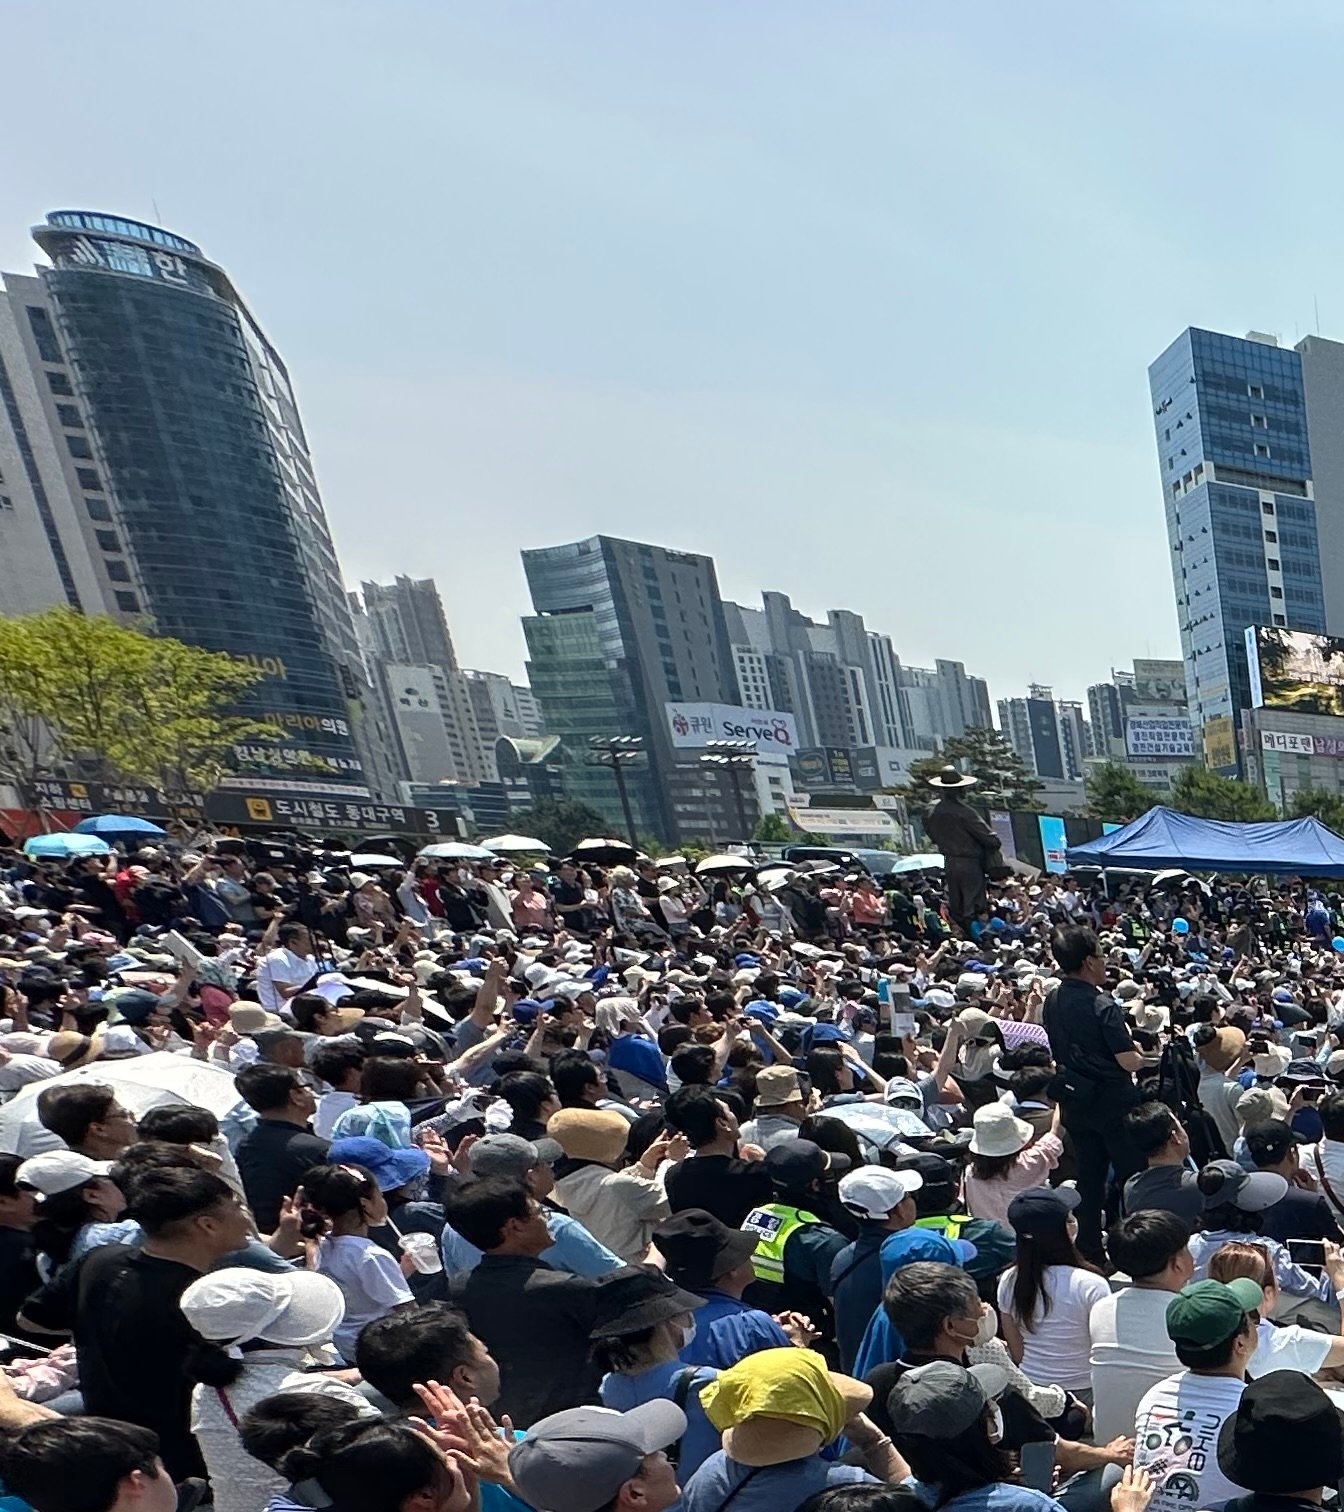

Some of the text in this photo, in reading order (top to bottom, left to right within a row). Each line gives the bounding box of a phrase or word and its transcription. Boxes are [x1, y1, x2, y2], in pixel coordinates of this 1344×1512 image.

[690, 717, 712, 734] 큐원
[1132, 743, 1193, 753] 영진건설기술교육
[275, 800, 341, 819] 도시철도
[346, 804, 406, 824] 동대구역
[424, 810, 440, 828] 3
